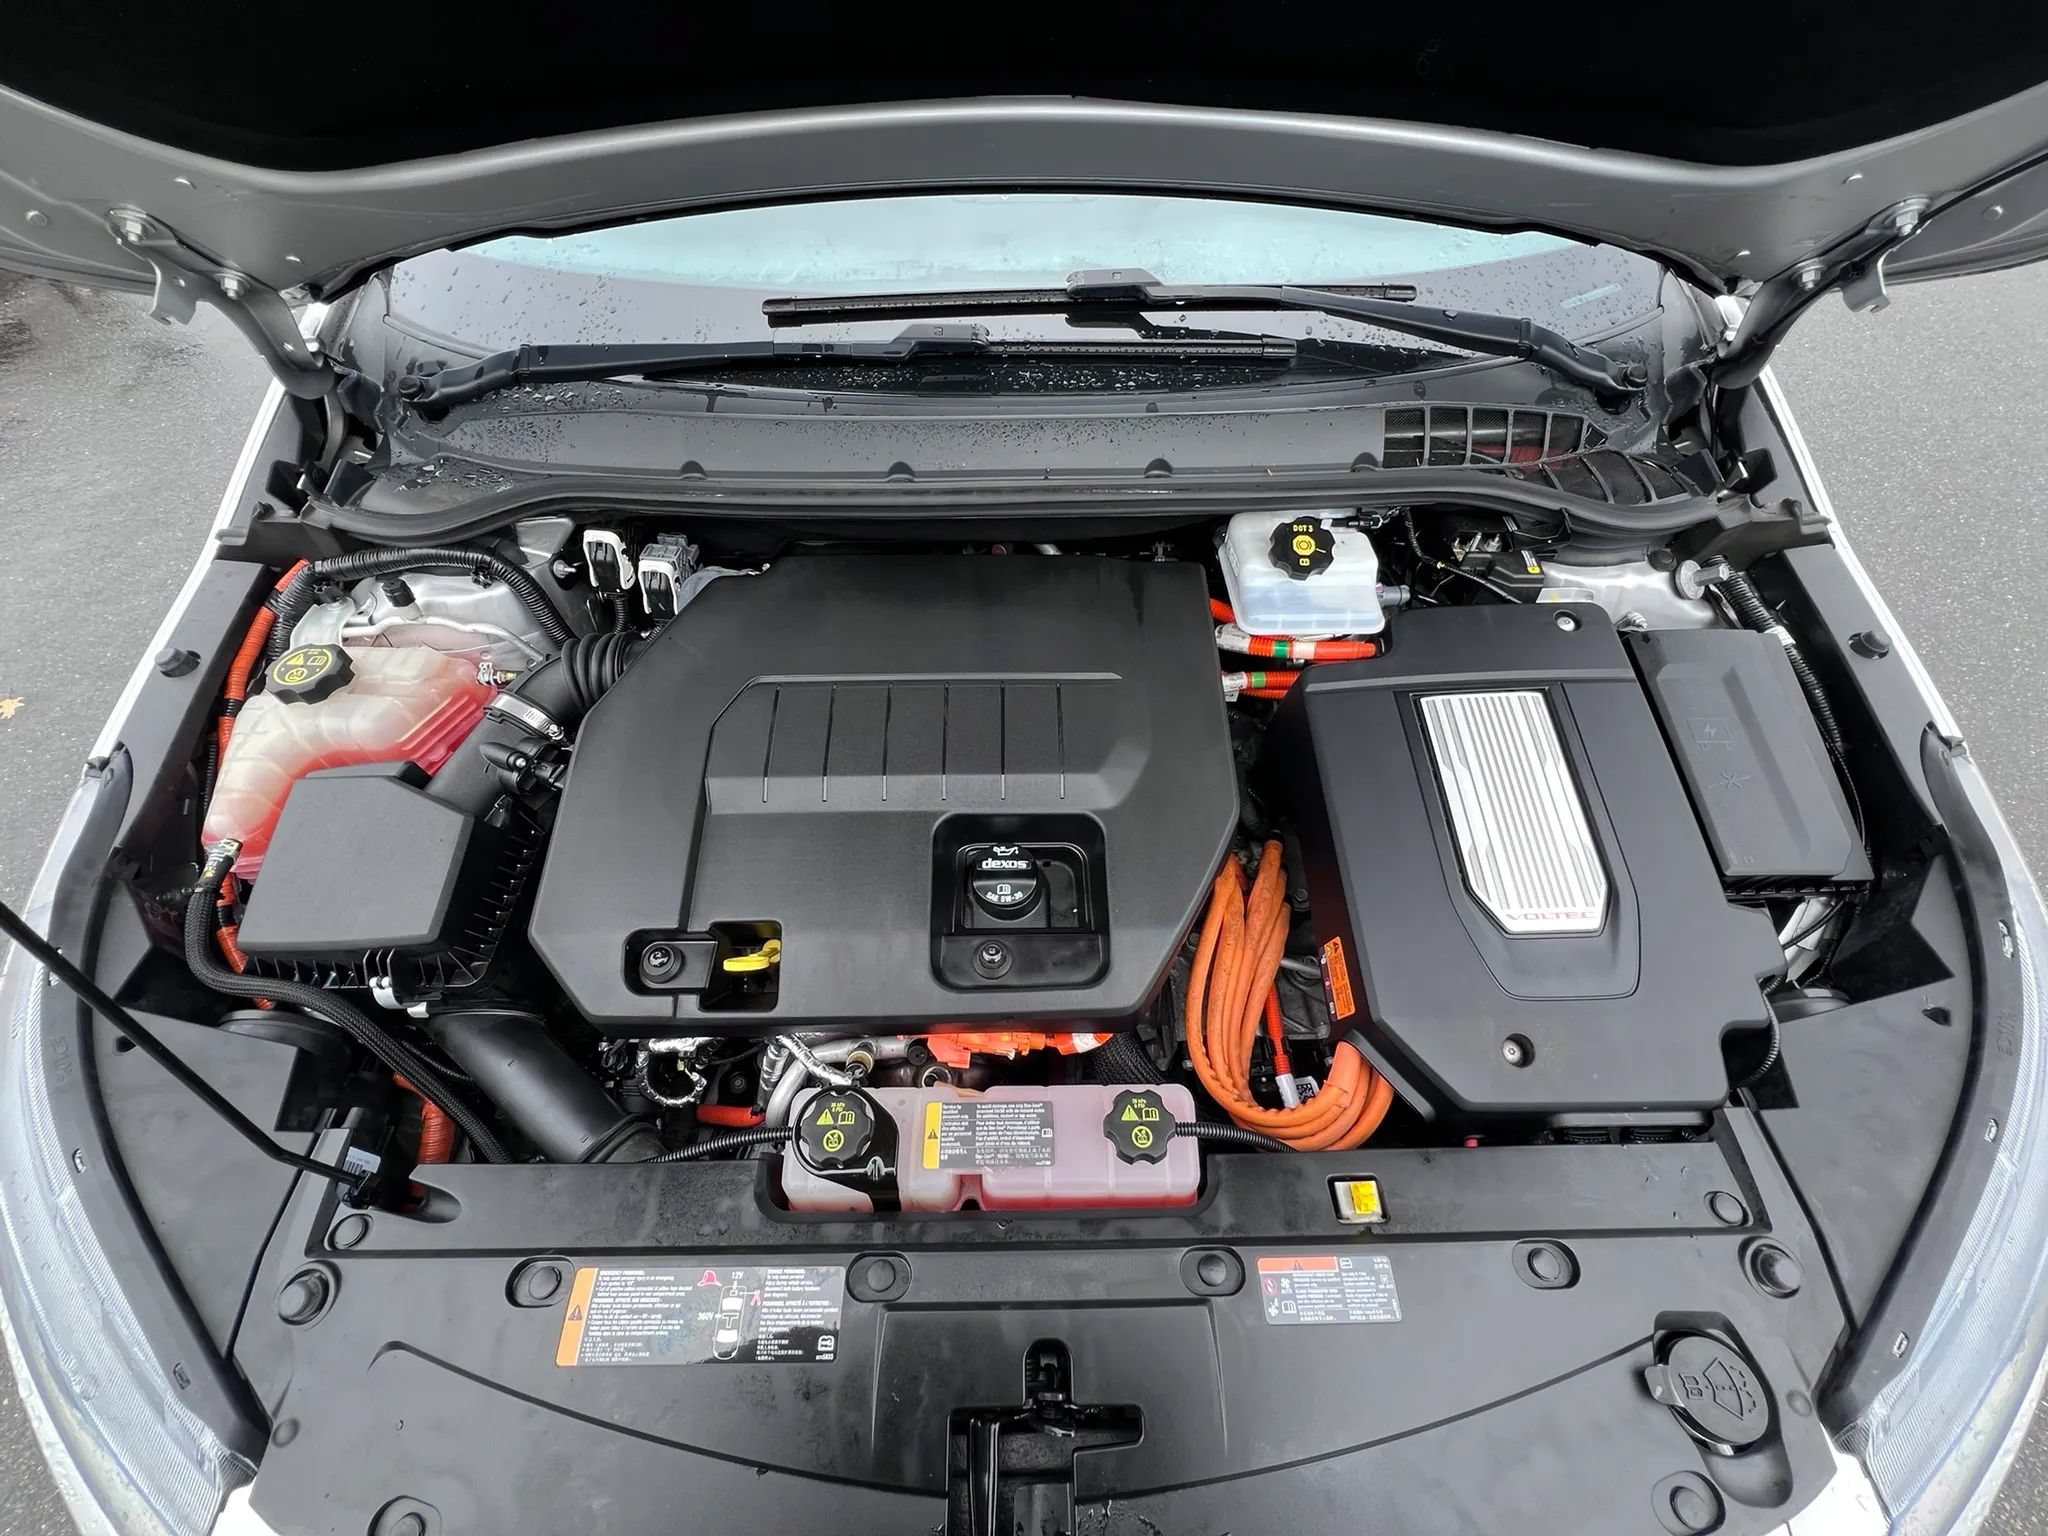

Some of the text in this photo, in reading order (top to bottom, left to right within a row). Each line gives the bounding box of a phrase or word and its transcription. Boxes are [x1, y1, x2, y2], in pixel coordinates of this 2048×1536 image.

[982, 858, 1028, 869] dexos
[986, 891, 999, 902] SAE
[1505, 912, 1597, 921] VOLTEC
[731, 1271, 744, 1279] 12V
